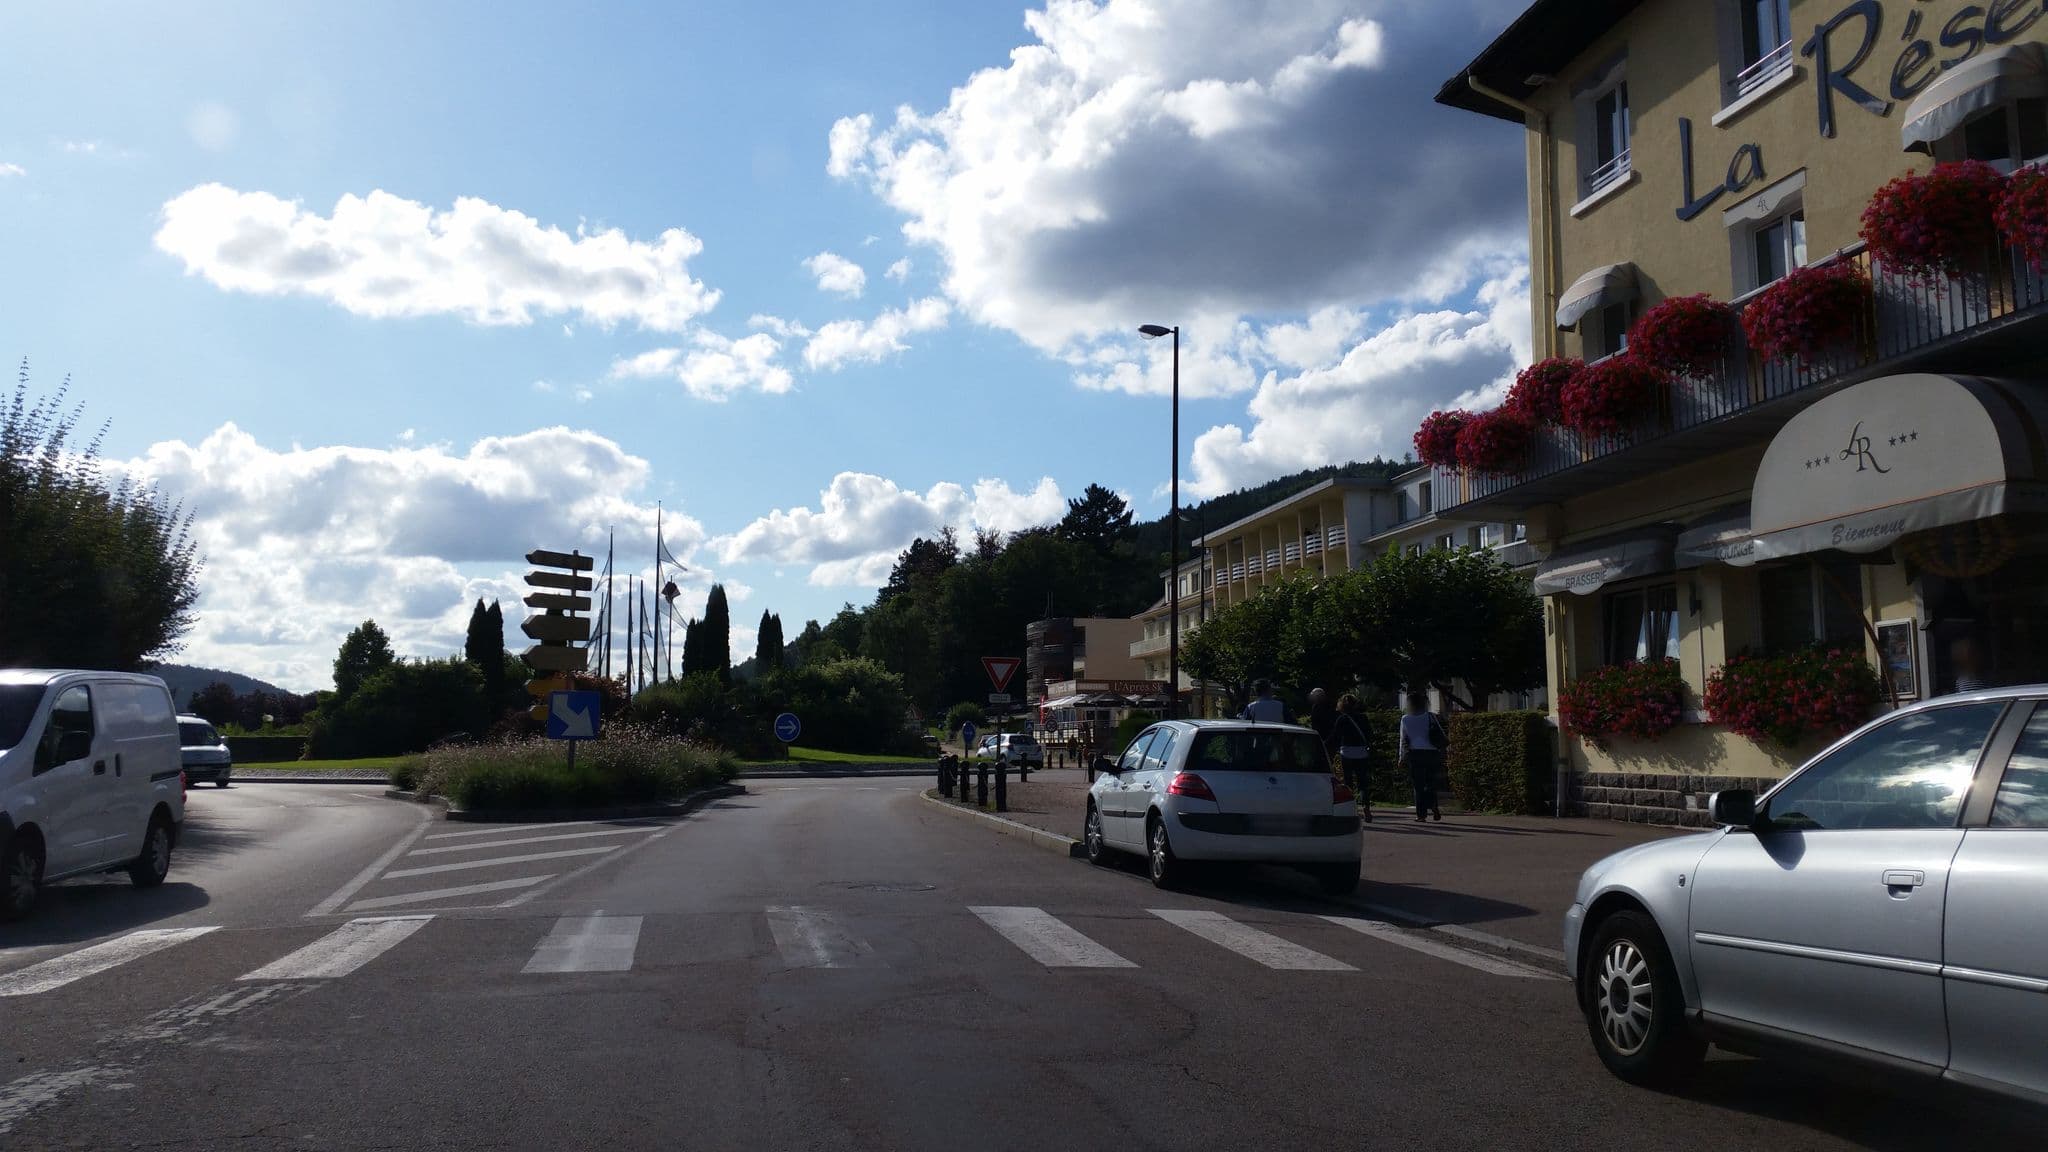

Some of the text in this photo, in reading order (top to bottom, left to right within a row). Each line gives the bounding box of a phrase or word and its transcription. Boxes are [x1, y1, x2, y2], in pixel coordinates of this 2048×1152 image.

[1676, 0, 2048, 222] La Rése
[1831, 518, 1906, 545] Bienvenue
[1565, 569, 1607, 589] BRASSERIE
